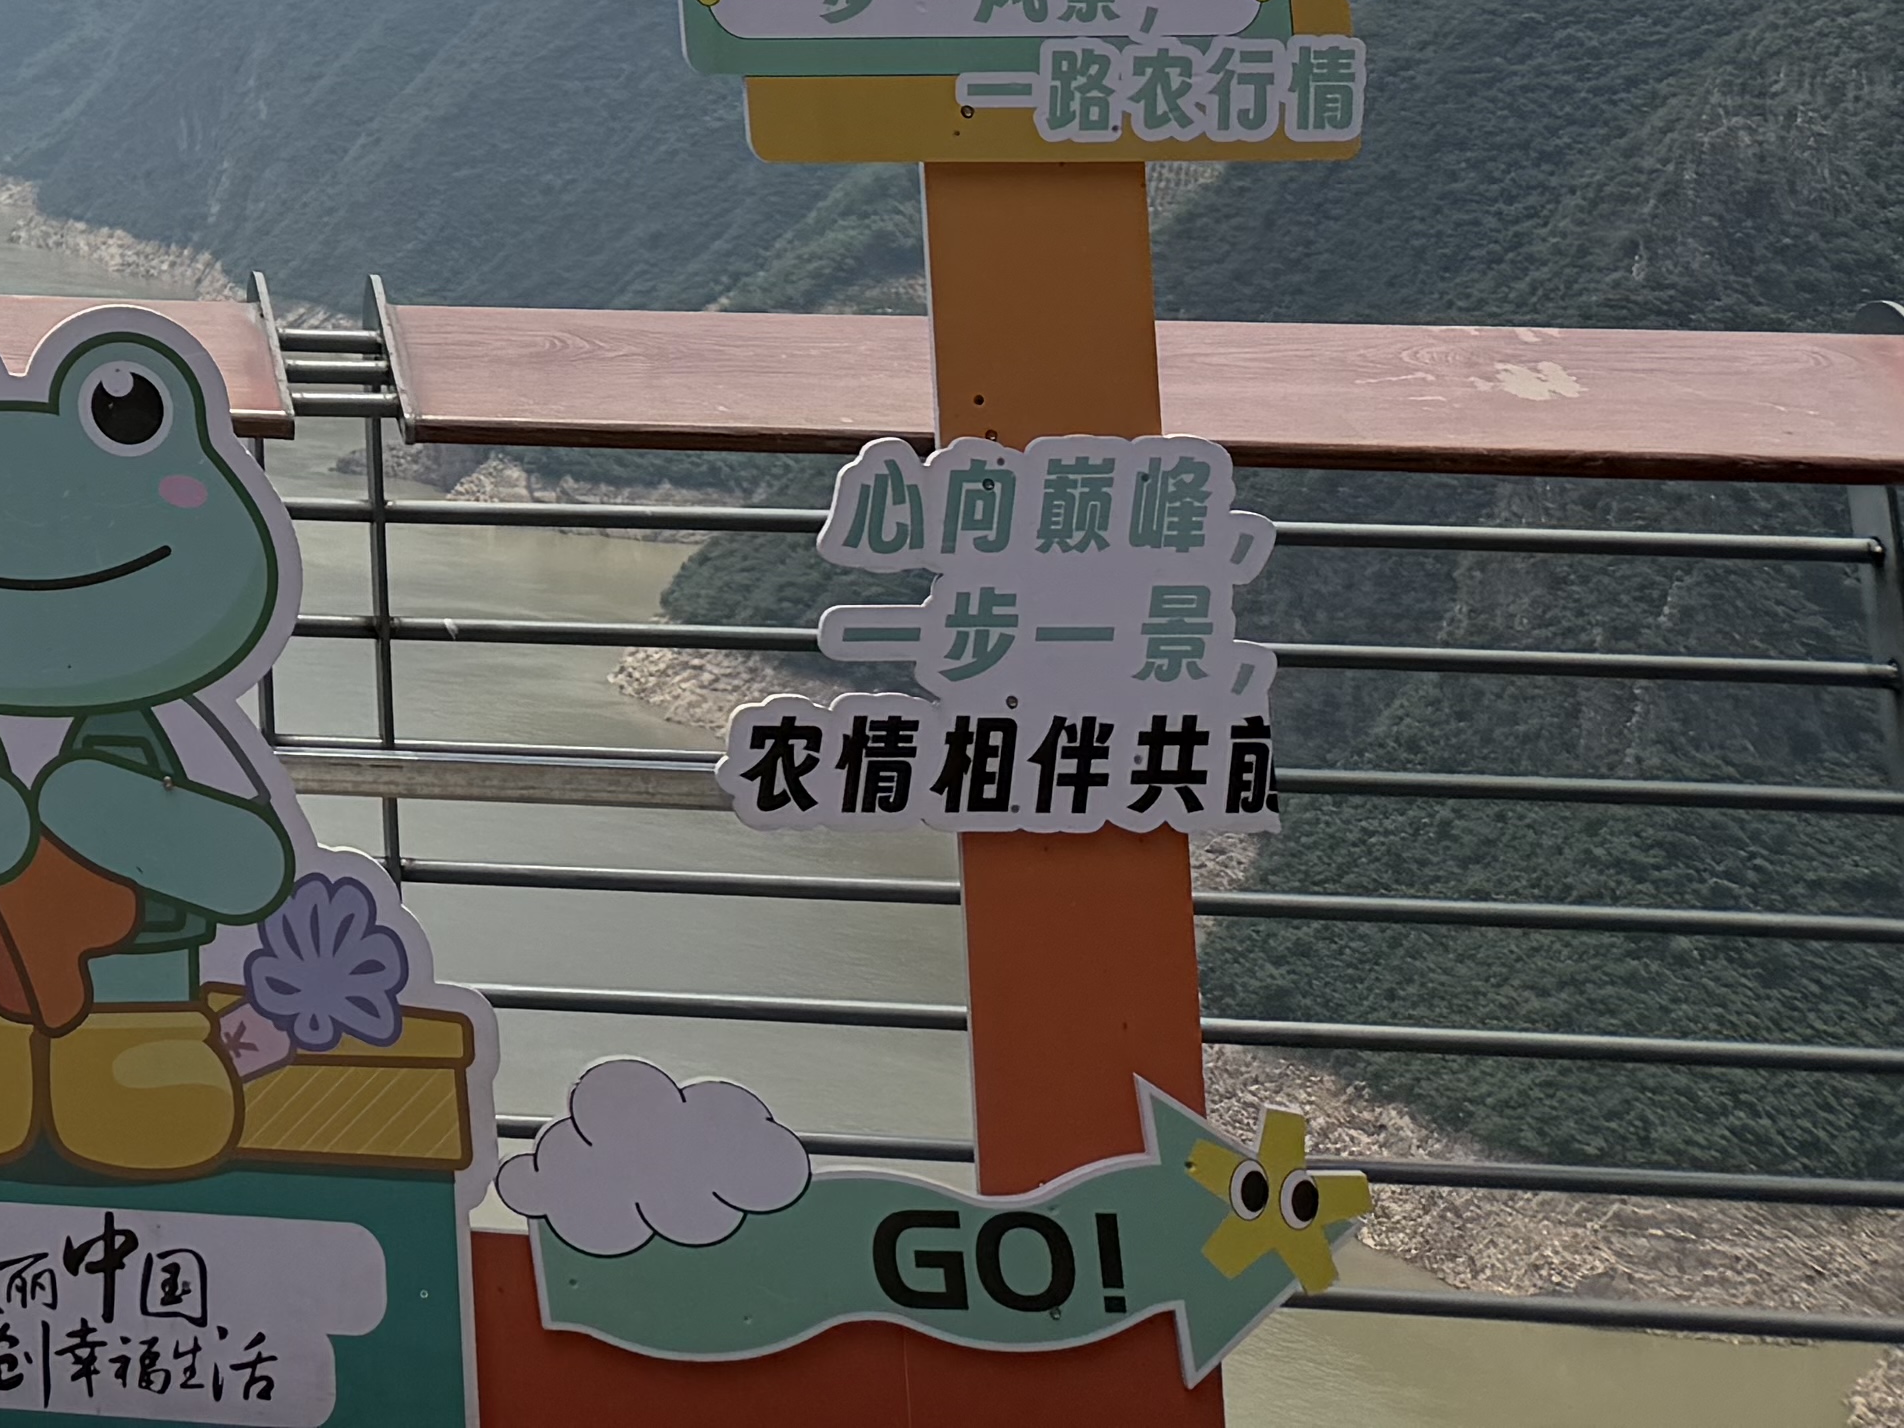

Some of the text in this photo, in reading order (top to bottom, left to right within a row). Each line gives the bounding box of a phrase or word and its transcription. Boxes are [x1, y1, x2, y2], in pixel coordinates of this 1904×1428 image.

[966, 45, 1358, 133] 一路农行情
[841, 456, 1256, 566] 心向巅峰，
[841, 584, 1256, 696] 一步一景，
[871, 1208, 1128, 1315] GO!
